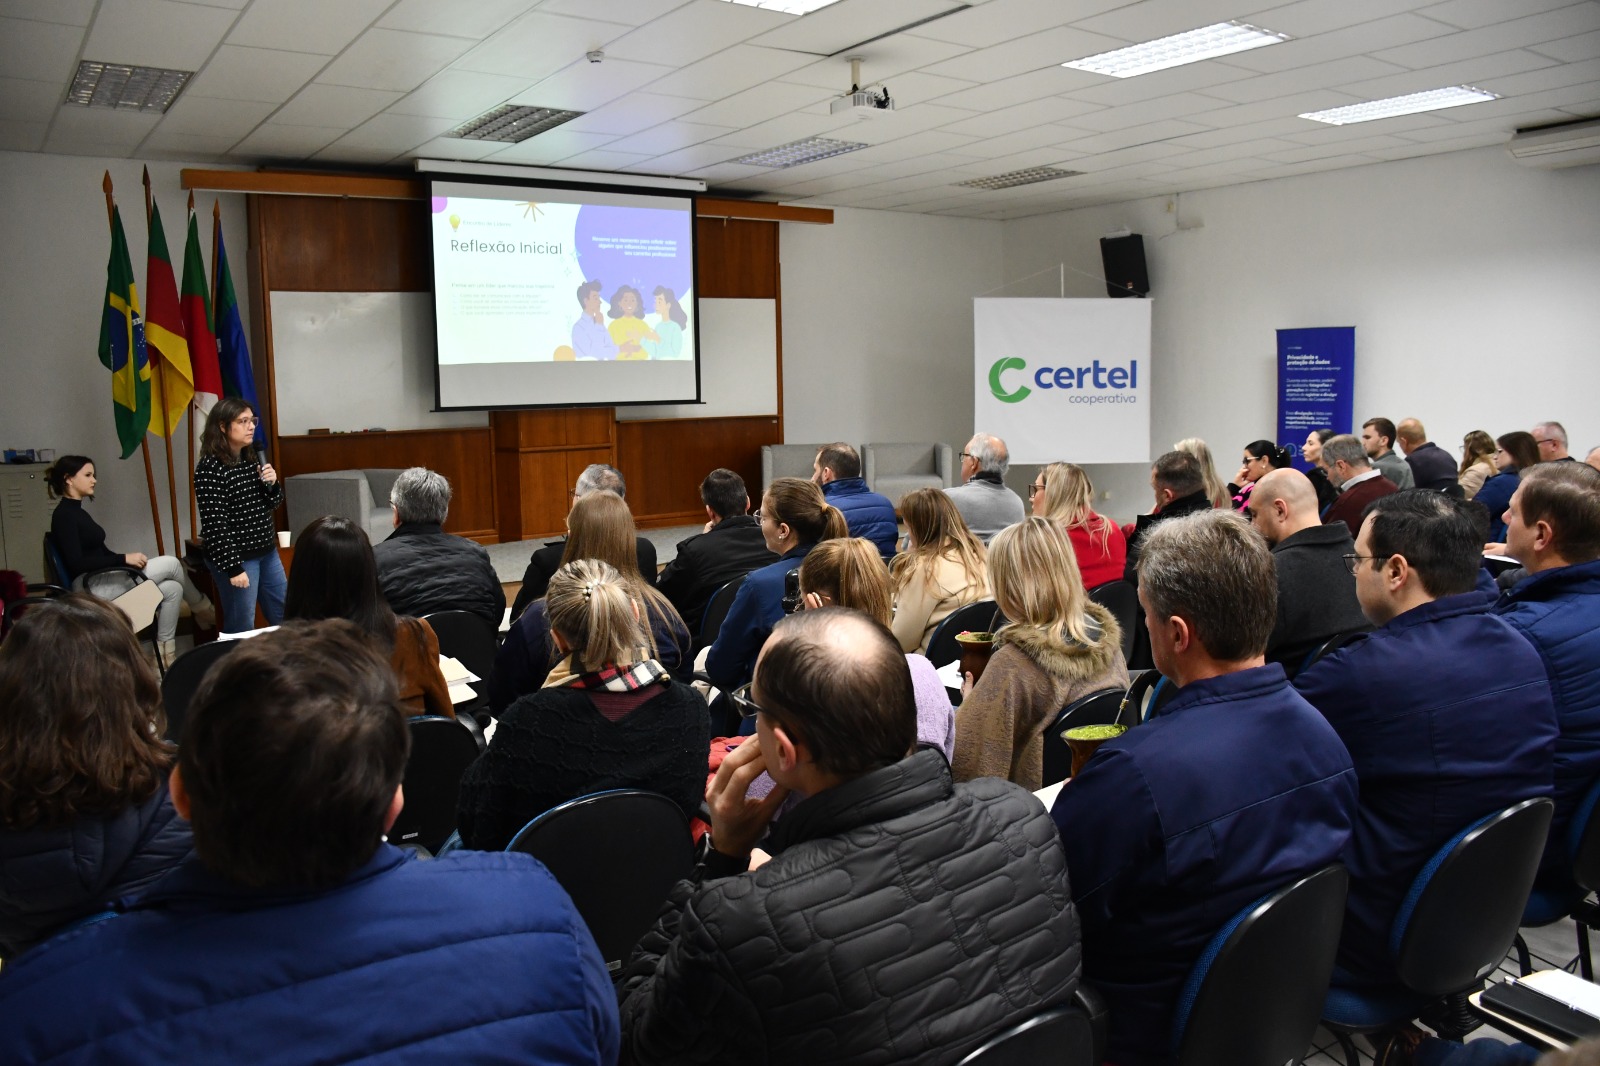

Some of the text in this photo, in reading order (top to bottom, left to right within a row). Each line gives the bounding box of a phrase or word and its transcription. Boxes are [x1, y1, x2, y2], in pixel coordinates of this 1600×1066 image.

[451, 239, 562, 254] Reflexão Inicial
[1034, 360, 1137, 389] certel
[1068, 393, 1136, 405] cooperativa
